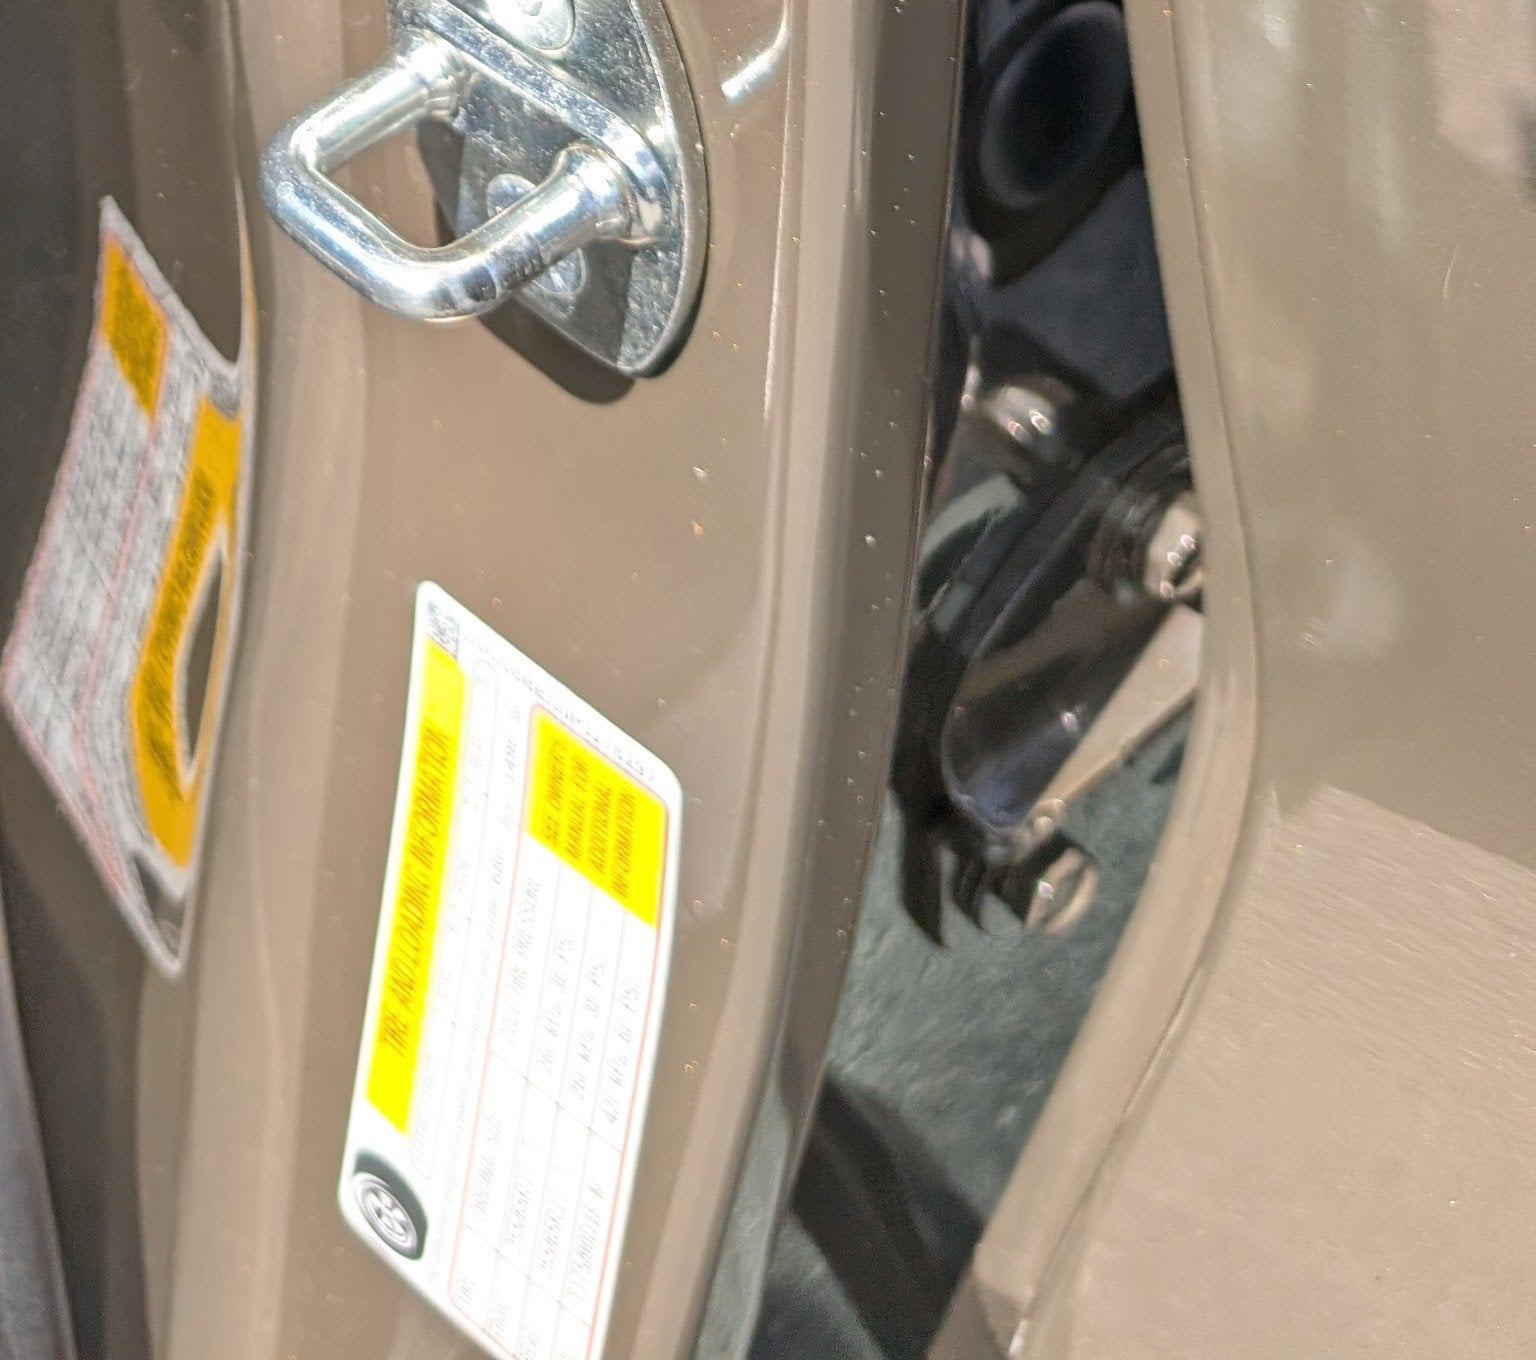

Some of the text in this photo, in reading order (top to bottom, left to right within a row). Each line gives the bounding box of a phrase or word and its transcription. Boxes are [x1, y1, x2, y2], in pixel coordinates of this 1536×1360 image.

[406, 717, 450, 872] INFORMATION
[392, 859, 432, 970] LOADING
[385, 952, 419, 1014] AND
